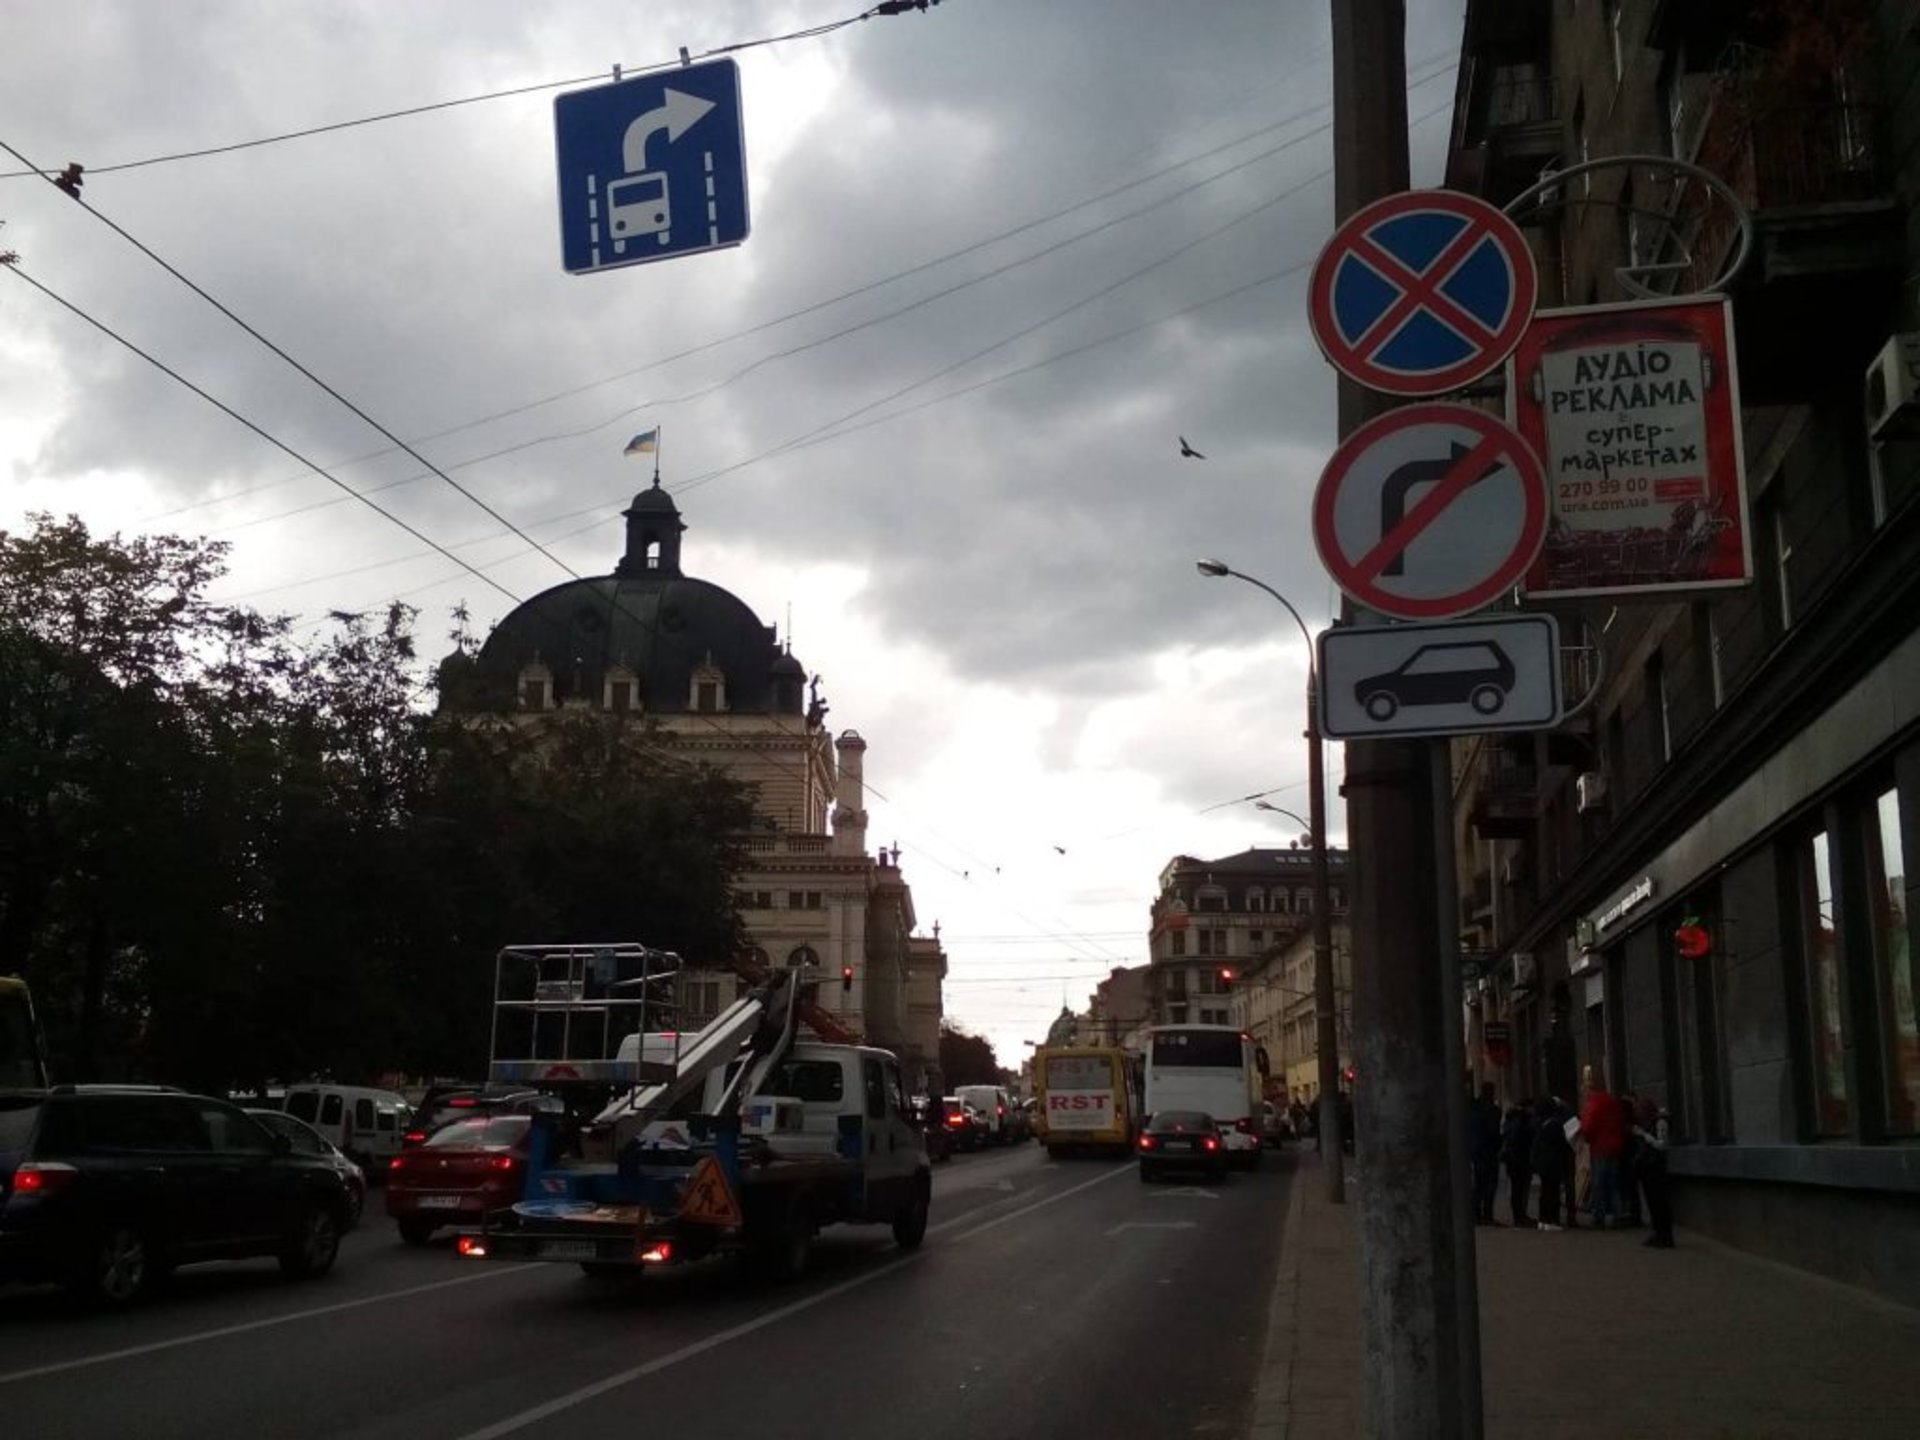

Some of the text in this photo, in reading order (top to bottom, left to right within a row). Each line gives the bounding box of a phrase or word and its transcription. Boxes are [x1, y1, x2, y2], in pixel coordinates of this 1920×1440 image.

[1575, 344, 1671, 384] АУДІО
[1551, 380, 1696, 414] РЕКЛАМА
[1560, 480, 1593, 498] 270
[1598, 479, 1620, 494] 99
[1625, 477, 1648, 492] 00
[1050, 1094, 1110, 1110] RST
